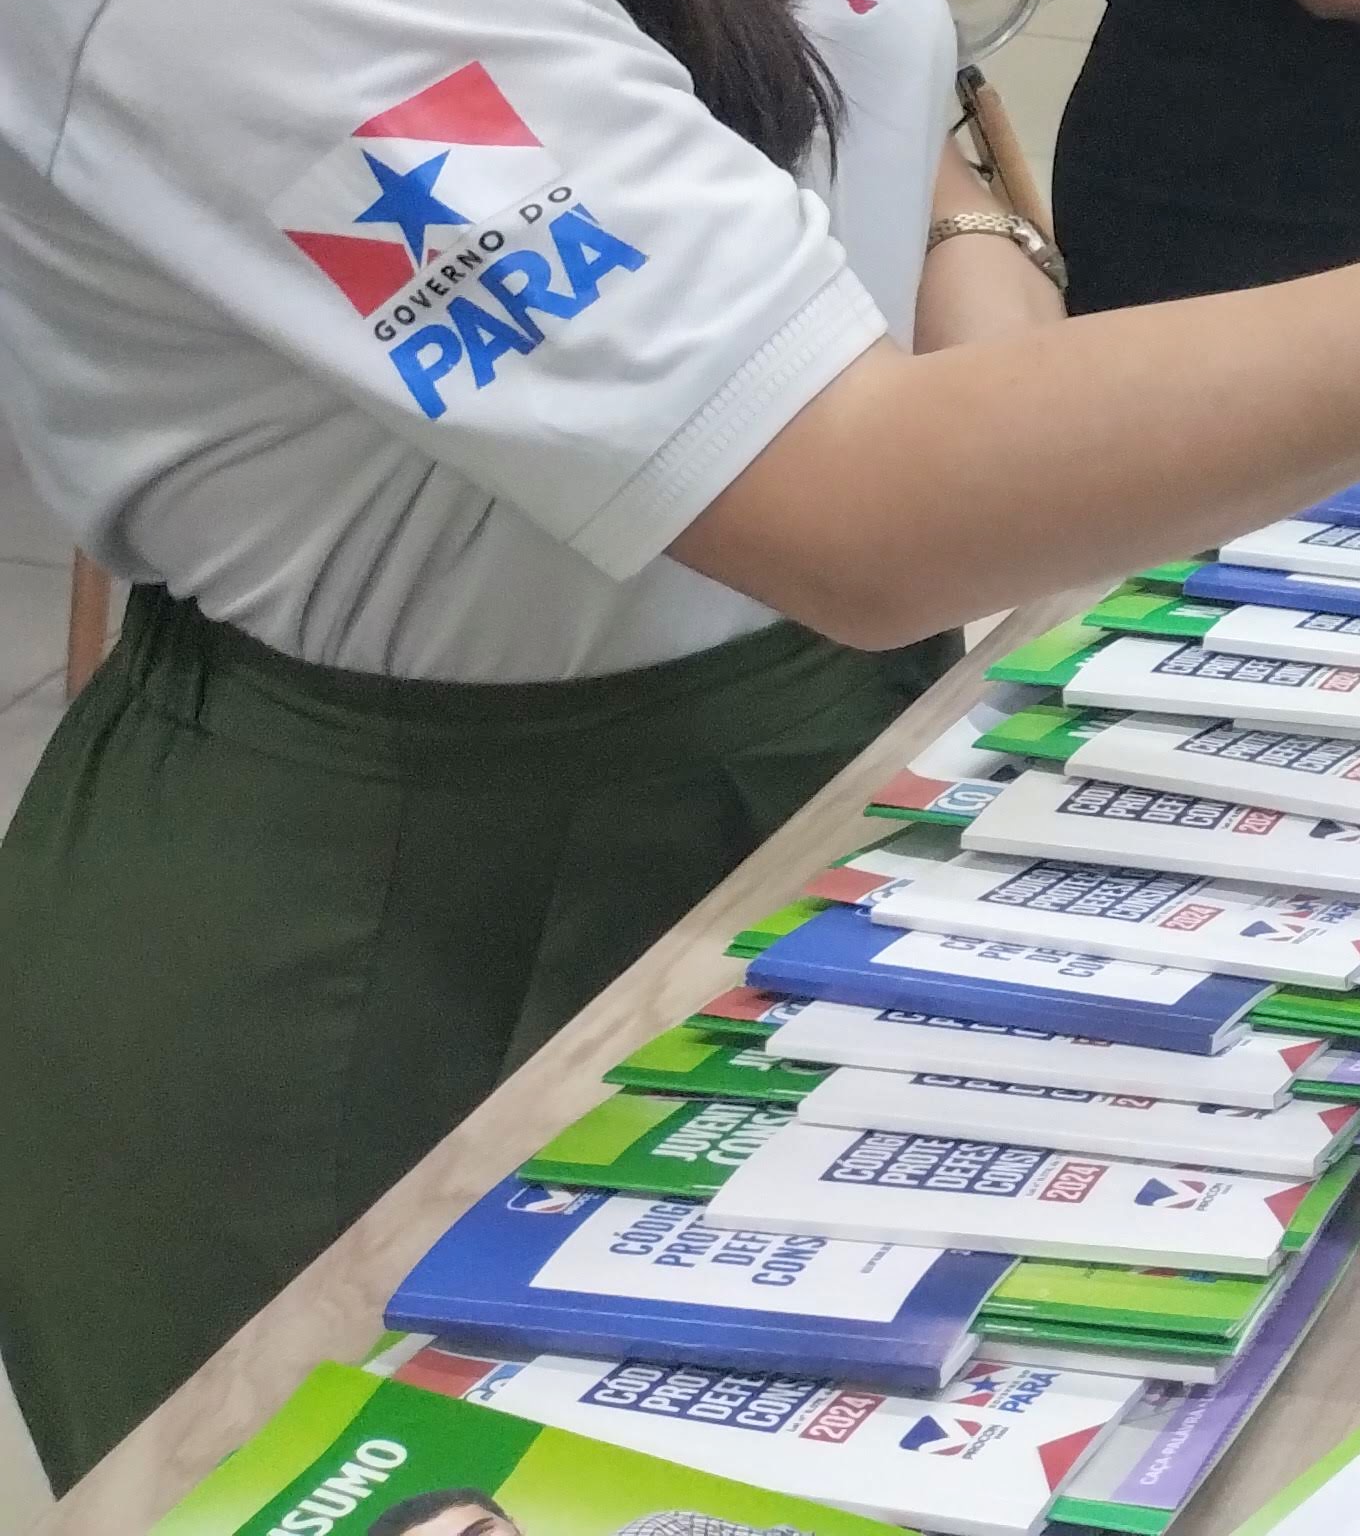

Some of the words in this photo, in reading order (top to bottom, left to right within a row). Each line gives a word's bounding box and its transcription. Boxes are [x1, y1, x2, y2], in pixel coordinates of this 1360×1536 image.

[373, 229, 506, 342] GOVERNO
[519, 185, 573, 225] DO
[832, 1132, 907, 1182] CÓDIG
[878, 1137, 955, 1187] PROTE
[923, 1142, 1001, 1191] DEFES
[1045, 1164, 1102, 1201] 2024
[751, 1234, 828, 1288] CONS
[808, 1395, 877, 1441] 2024
[962, 1424, 1003, 1461] PROCON
[1139, 1394, 1216, 1487] CAÇA-PALAVRA
